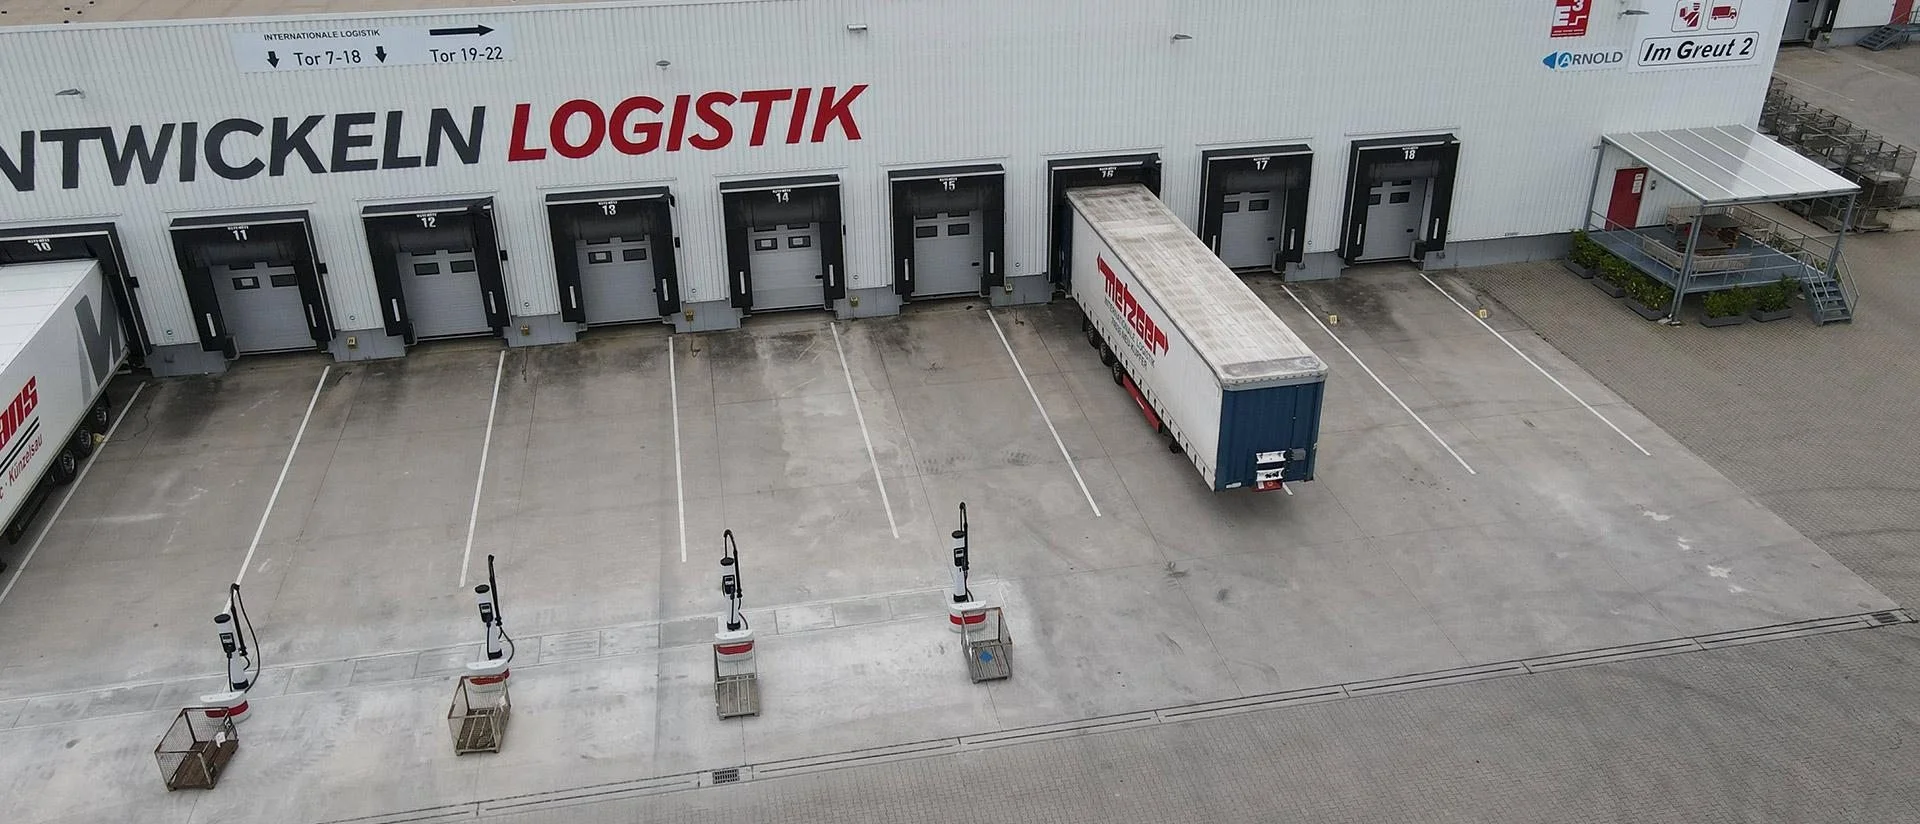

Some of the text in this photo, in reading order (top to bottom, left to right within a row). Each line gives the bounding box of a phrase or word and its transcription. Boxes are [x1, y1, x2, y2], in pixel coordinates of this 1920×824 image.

[264, 29, 380, 41] INTERNATIONALE LOGISTIK
[429, 46, 503, 63] Tor 19-22
[1643, 37, 1754, 62] Im Greut 2
[293, 49, 361, 66] Tor 7-18
[1558, 51, 1623, 68] ARNOLD
[508, 84, 869, 162] LOGISTIK
[1404, 149, 1416, 161] 18
[1256, 160, 1268, 171] 17
[943, 180, 956, 192] 15
[775, 192, 790, 204] 14
[602, 204, 617, 216] 13
[421, 217, 437, 229] 12
[232, 229, 248, 241] 11
[33, 241, 52, 252] 10
[8, 433, 43, 487] Künzelsau
